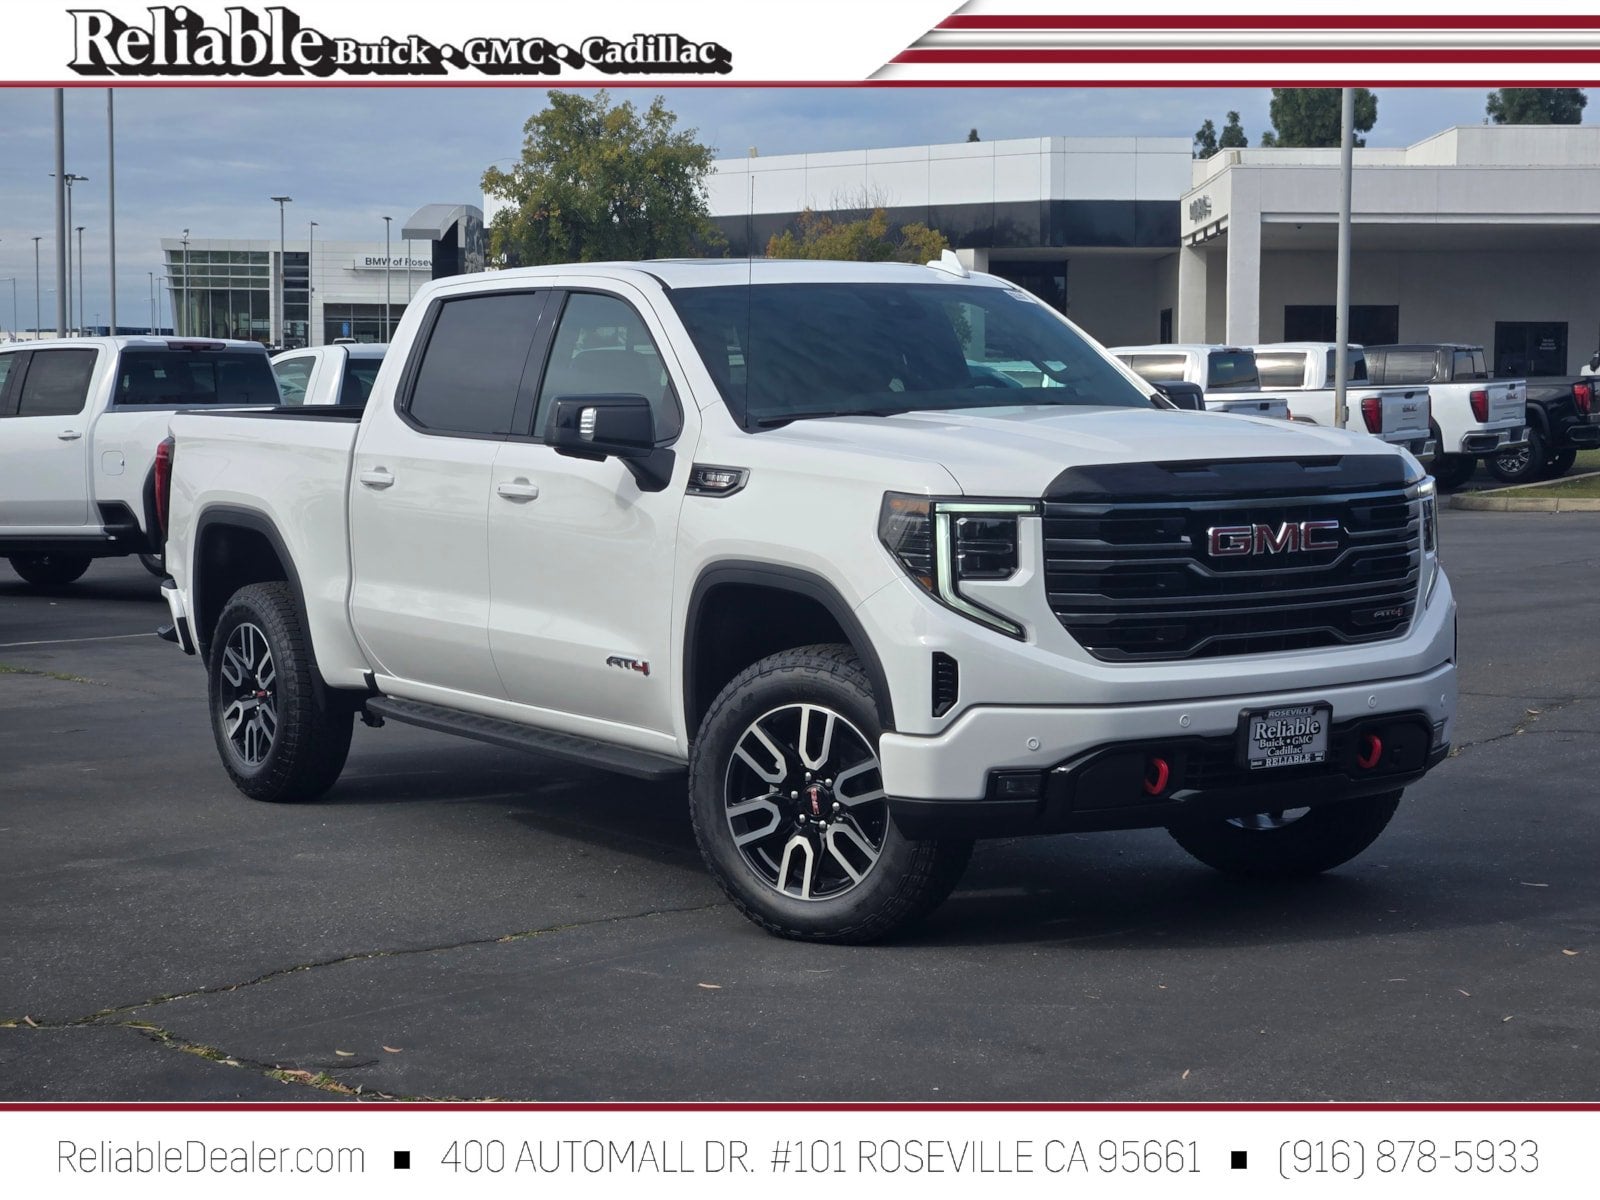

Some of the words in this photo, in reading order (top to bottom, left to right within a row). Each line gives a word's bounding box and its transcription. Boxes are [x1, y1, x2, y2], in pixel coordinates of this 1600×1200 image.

[365, 257, 391, 266] BMW
[392, 257, 402, 266] of
[1207, 520, 1339, 557] GMC
[606, 656, 650, 677] AT4
[1255, 717, 1320, 739] Reliable
[1259, 738, 1285, 748] Buick
[1292, 735, 1313, 745] GMC
[1267, 745, 1302, 757] Cadillac
[1265, 753, 1310, 767] RELIABLE
